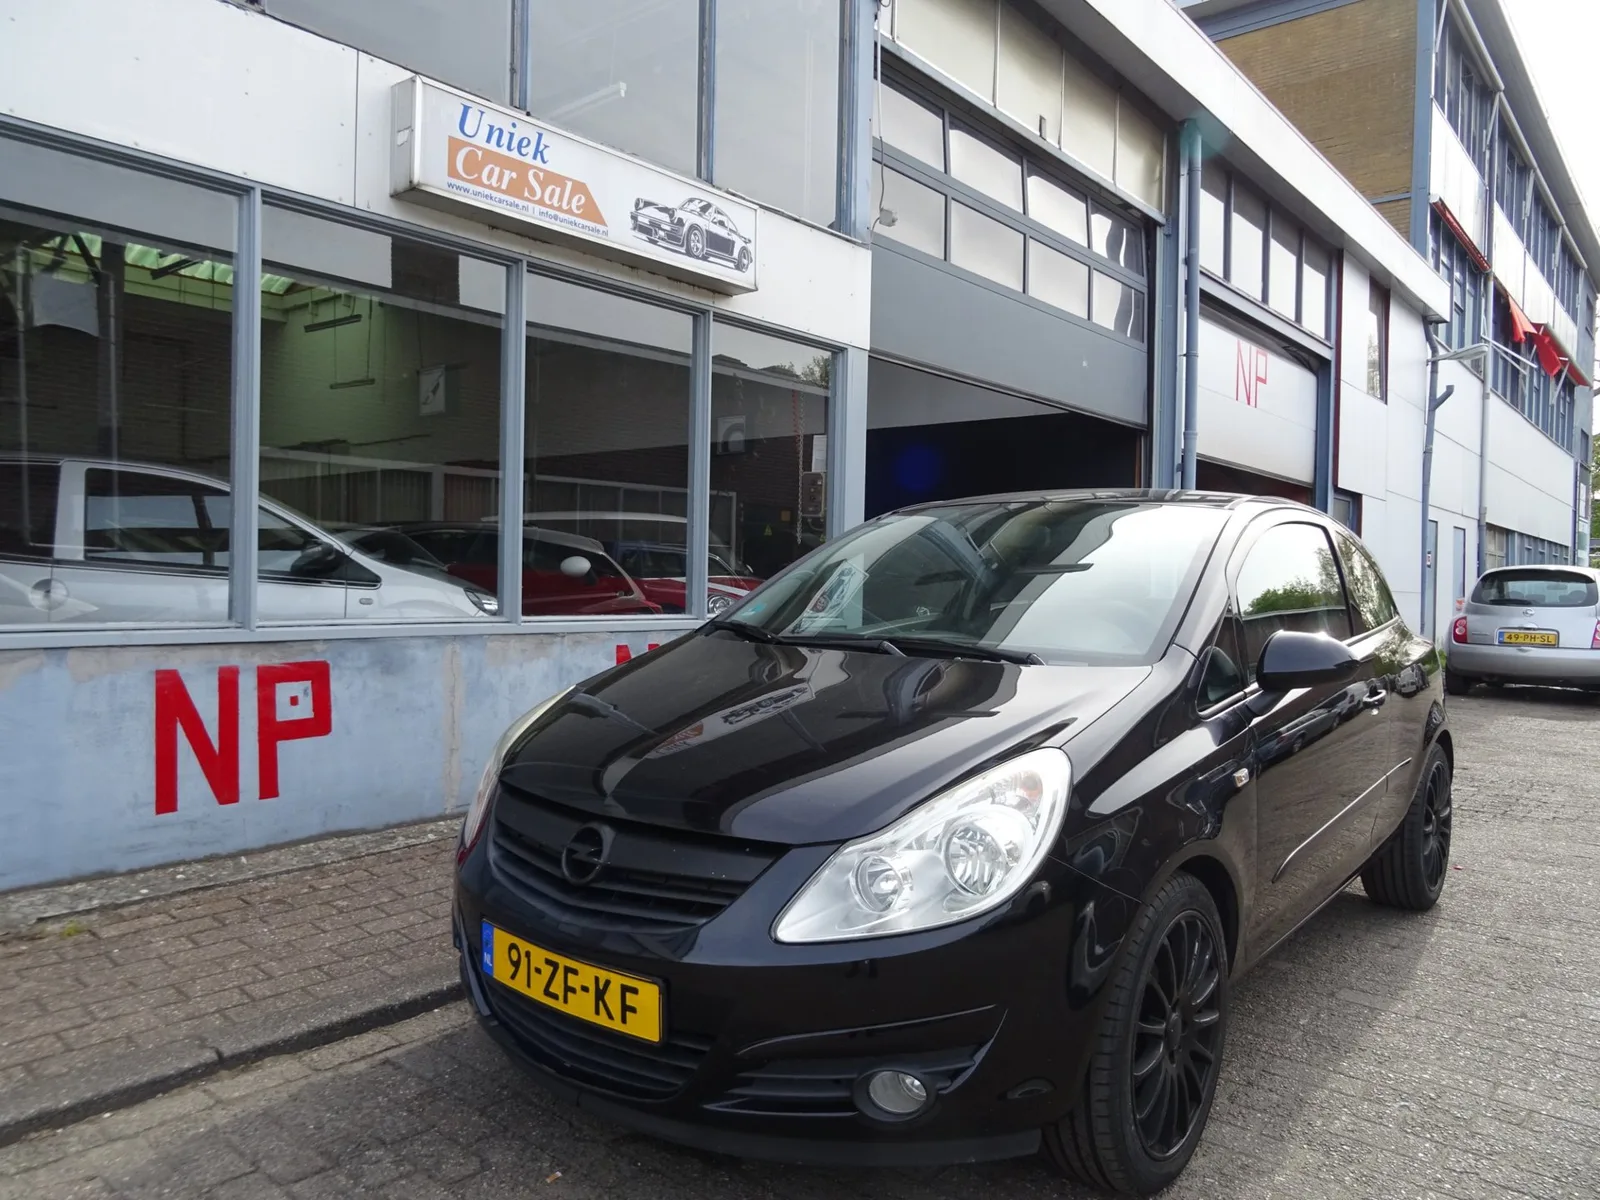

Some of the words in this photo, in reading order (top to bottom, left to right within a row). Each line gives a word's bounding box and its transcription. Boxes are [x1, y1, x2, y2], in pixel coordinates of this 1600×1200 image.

[458, 102, 550, 164] Uniek
[447, 181, 529, 212] www.uniekcarsale.nl
[538, 209, 609, 237] info@uniekcarsale.nl
[455, 146, 517, 190] Car
[524, 168, 586, 214] Sale
[1235, 339, 1268, 409] NP
[1506, 633, 1552, 643] 49-PH-SL
[155, 660, 332, 815] NP
[507, 942, 639, 1025] 91-ZF-KF
